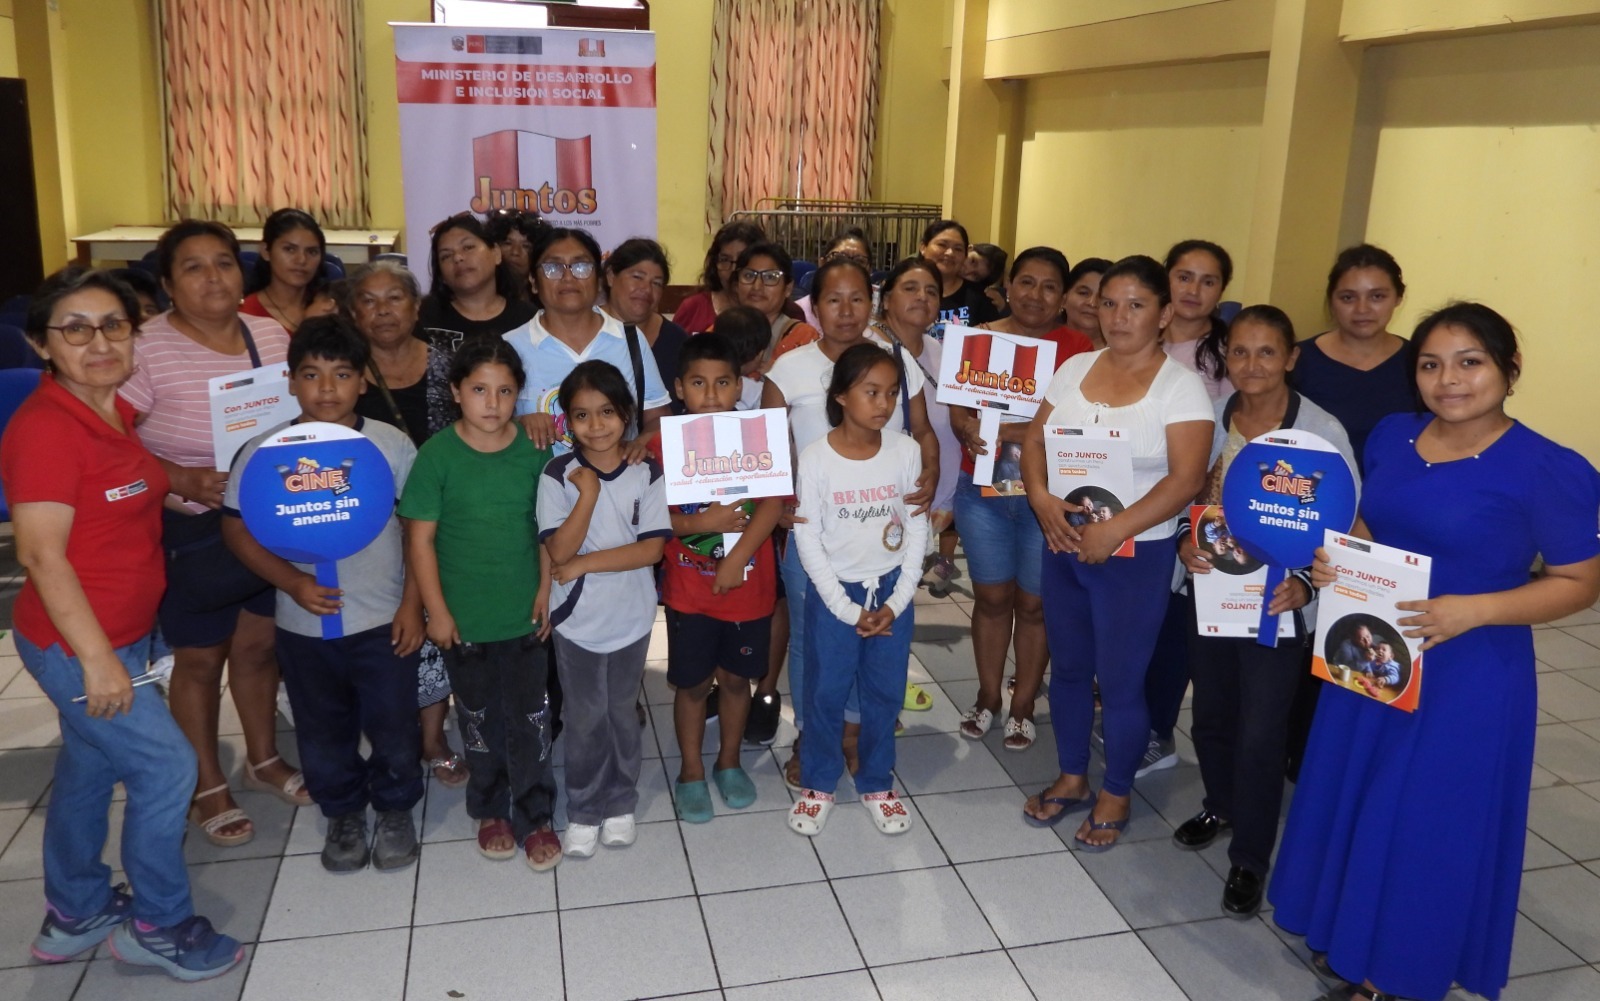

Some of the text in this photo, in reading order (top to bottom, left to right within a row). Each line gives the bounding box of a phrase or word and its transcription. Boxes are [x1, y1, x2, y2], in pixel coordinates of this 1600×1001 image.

[421, 69, 633, 85] MINISTERIO DE DESARROLLO
[456, 86, 465, 97] E
[553, 88, 605, 100] SOCIAL
[470, 176, 598, 215] Juntos
[955, 360, 1037, 396] Juntos
[224, 405, 242, 414] Con
[243, 395, 280, 410] JUNTOS
[681, 449, 774, 477] Juntos
[1075, 451, 1108, 460] JUNTOS
[285, 469, 343, 492] CINE
[1261, 474, 1312, 496] CINE
[275, 496, 360, 516] Juntos sin
[832, 489, 856, 505] BE
[292, 510, 351, 526] anemia
[837, 504, 890, 523] So stylish!
[1248, 498, 1320, 521] Juntos sin
[1259, 515, 1309, 532] anemia
[1334, 564, 1398, 589] Con JUNTOS
[1221, 602, 1258, 610] JUNTOS
